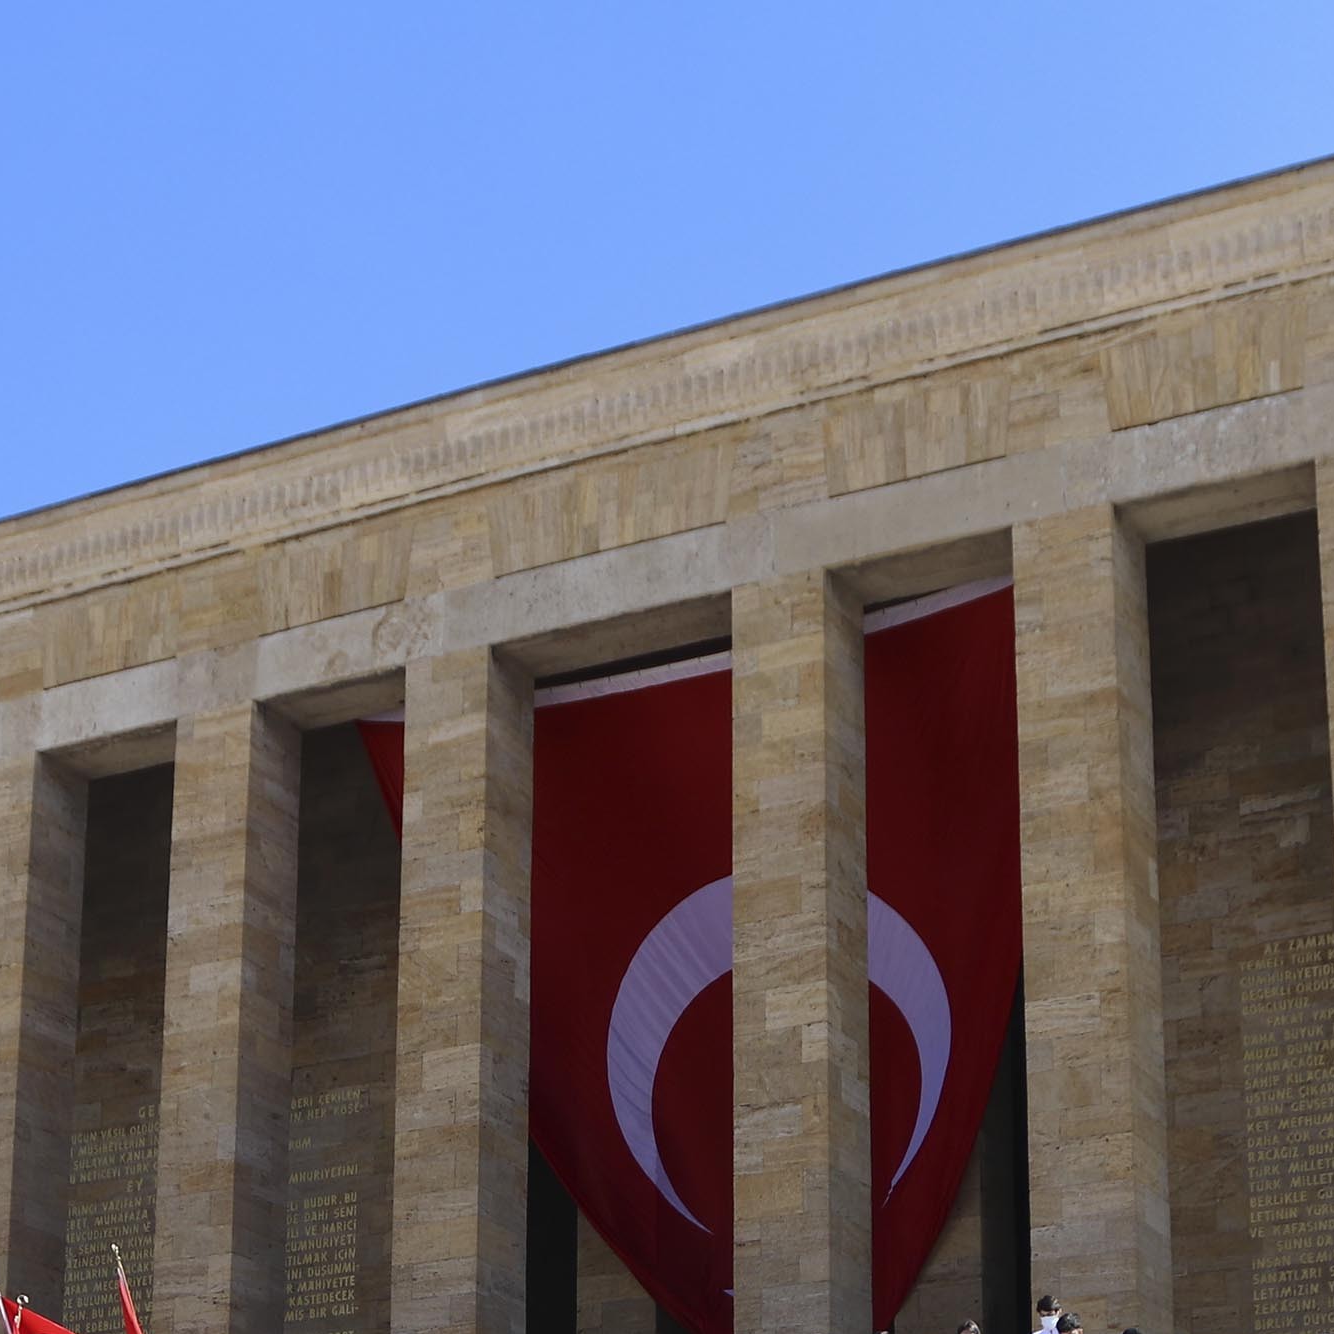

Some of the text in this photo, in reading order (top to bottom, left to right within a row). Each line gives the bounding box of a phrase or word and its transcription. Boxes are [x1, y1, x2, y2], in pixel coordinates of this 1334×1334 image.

[344, 1191, 358, 1204] BU
[1250, 1226, 1266, 1239] VE
[1253, 1269, 1322, 1286] SANATLARI
[288, 1290, 355, 1309] KASTEDECEK
